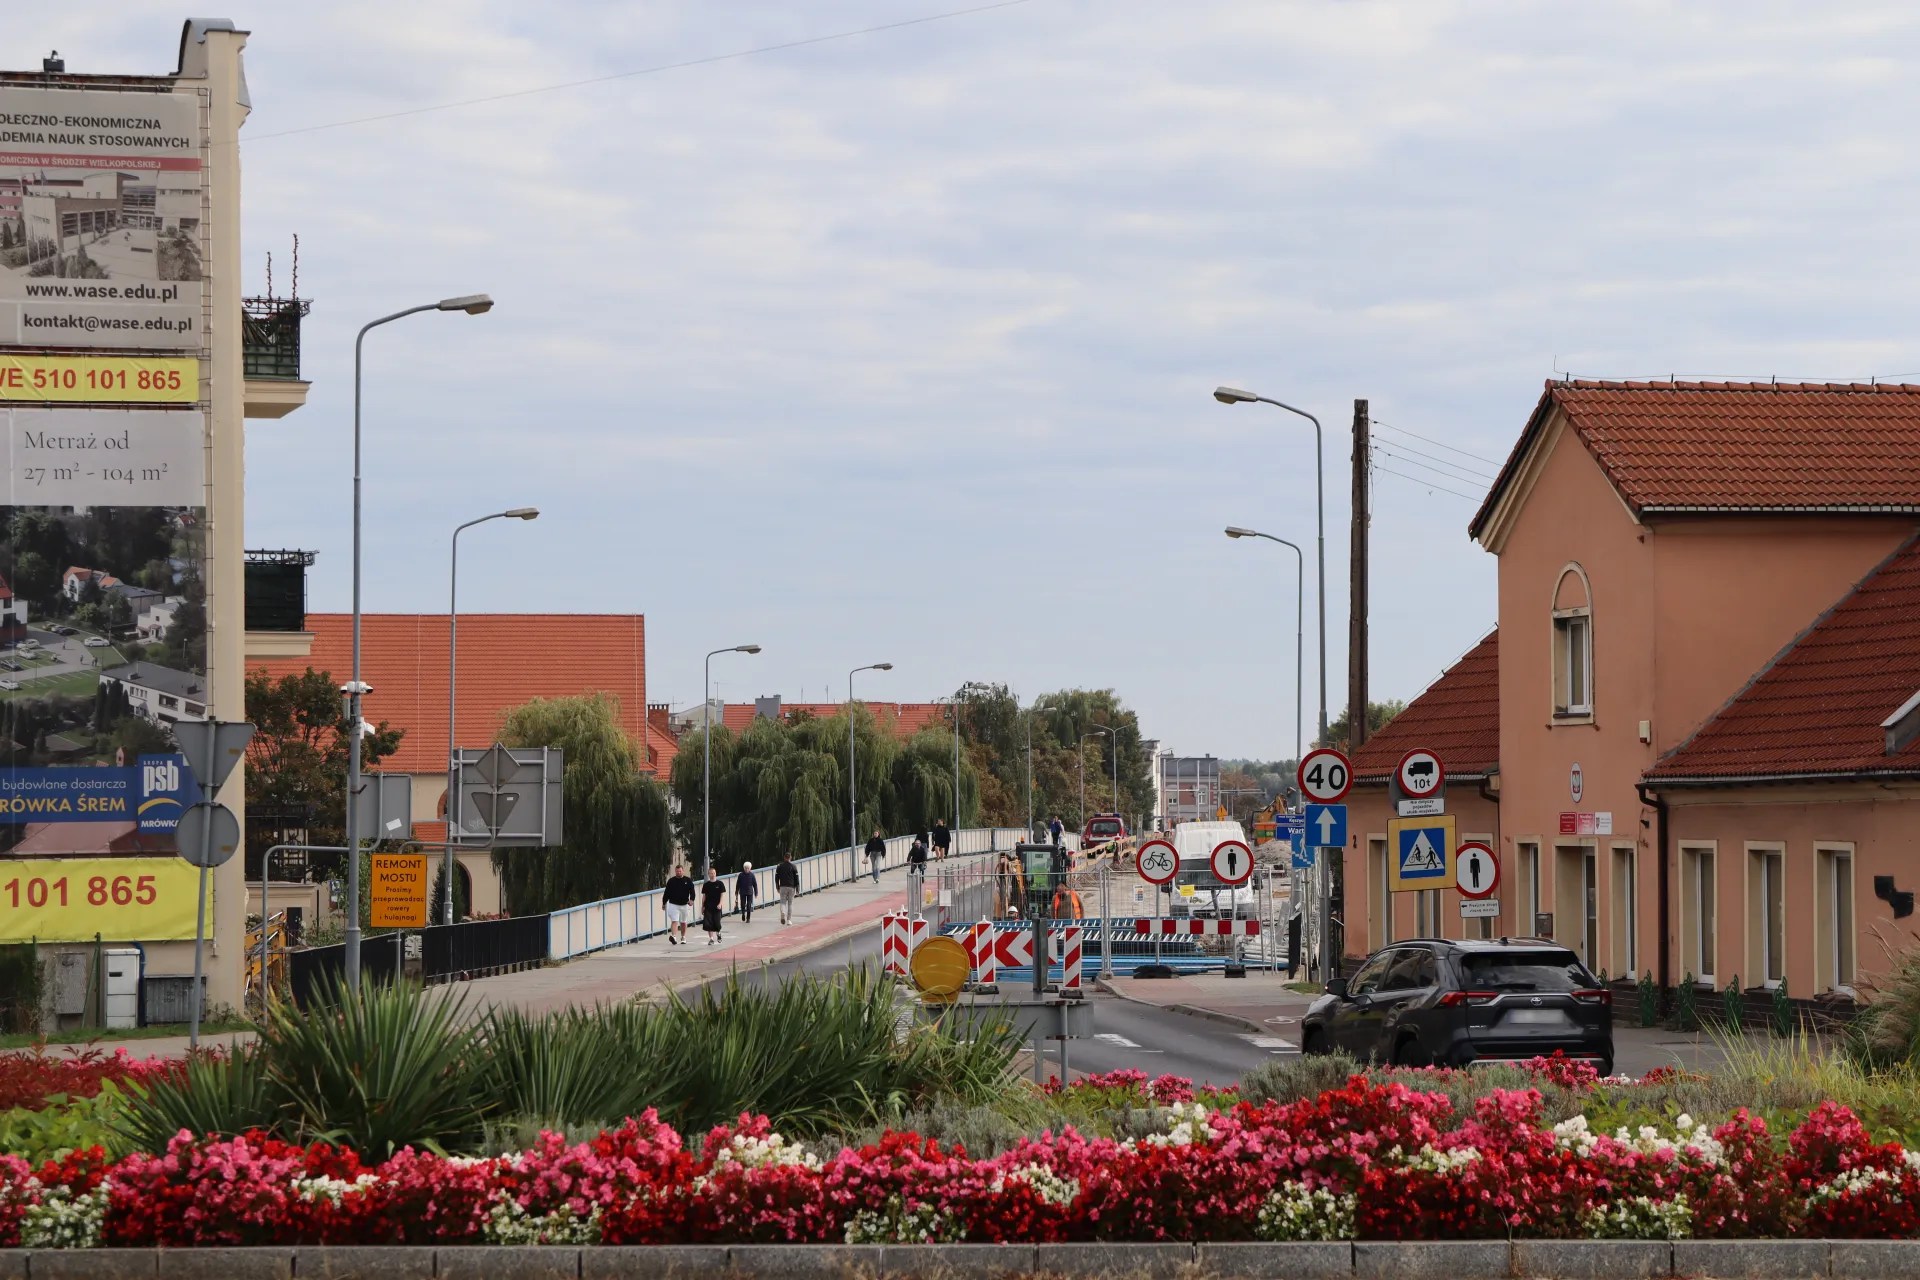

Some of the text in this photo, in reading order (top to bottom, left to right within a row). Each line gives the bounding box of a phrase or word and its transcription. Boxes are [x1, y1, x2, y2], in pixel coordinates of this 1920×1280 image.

[0, 113, 161, 130] OŁECZNO-EKONOMICZNA
[0, 131, 189, 148] DEMIA NAUK STOSOWANYCH
[41, 157, 50, 165] W
[52, 156, 87, 167] ŚRODZIE
[89, 158, 161, 169] WIELKOPOLSKIEJ
[26, 284, 178, 302] www.wase.edu.pl
[24, 314, 192, 333] kontakt@wase.edu.pl
[33, 368, 76, 389] 510
[86, 369, 126, 390] 101
[137, 370, 181, 390] 865
[24, 430, 130, 449] Metraż od
[24, 468, 46, 486] 27
[103, 469, 135, 485] 104
[2, 778, 127, 790] budowlane dostarcza
[143, 760, 179, 797] psb
[1306, 763, 1346, 790] 40
[77, 793, 126, 812] ŚREM
[375, 859, 422, 869] REMONT
[380, 873, 417, 883] MOSTU
[4, 875, 157, 908] 101 865
